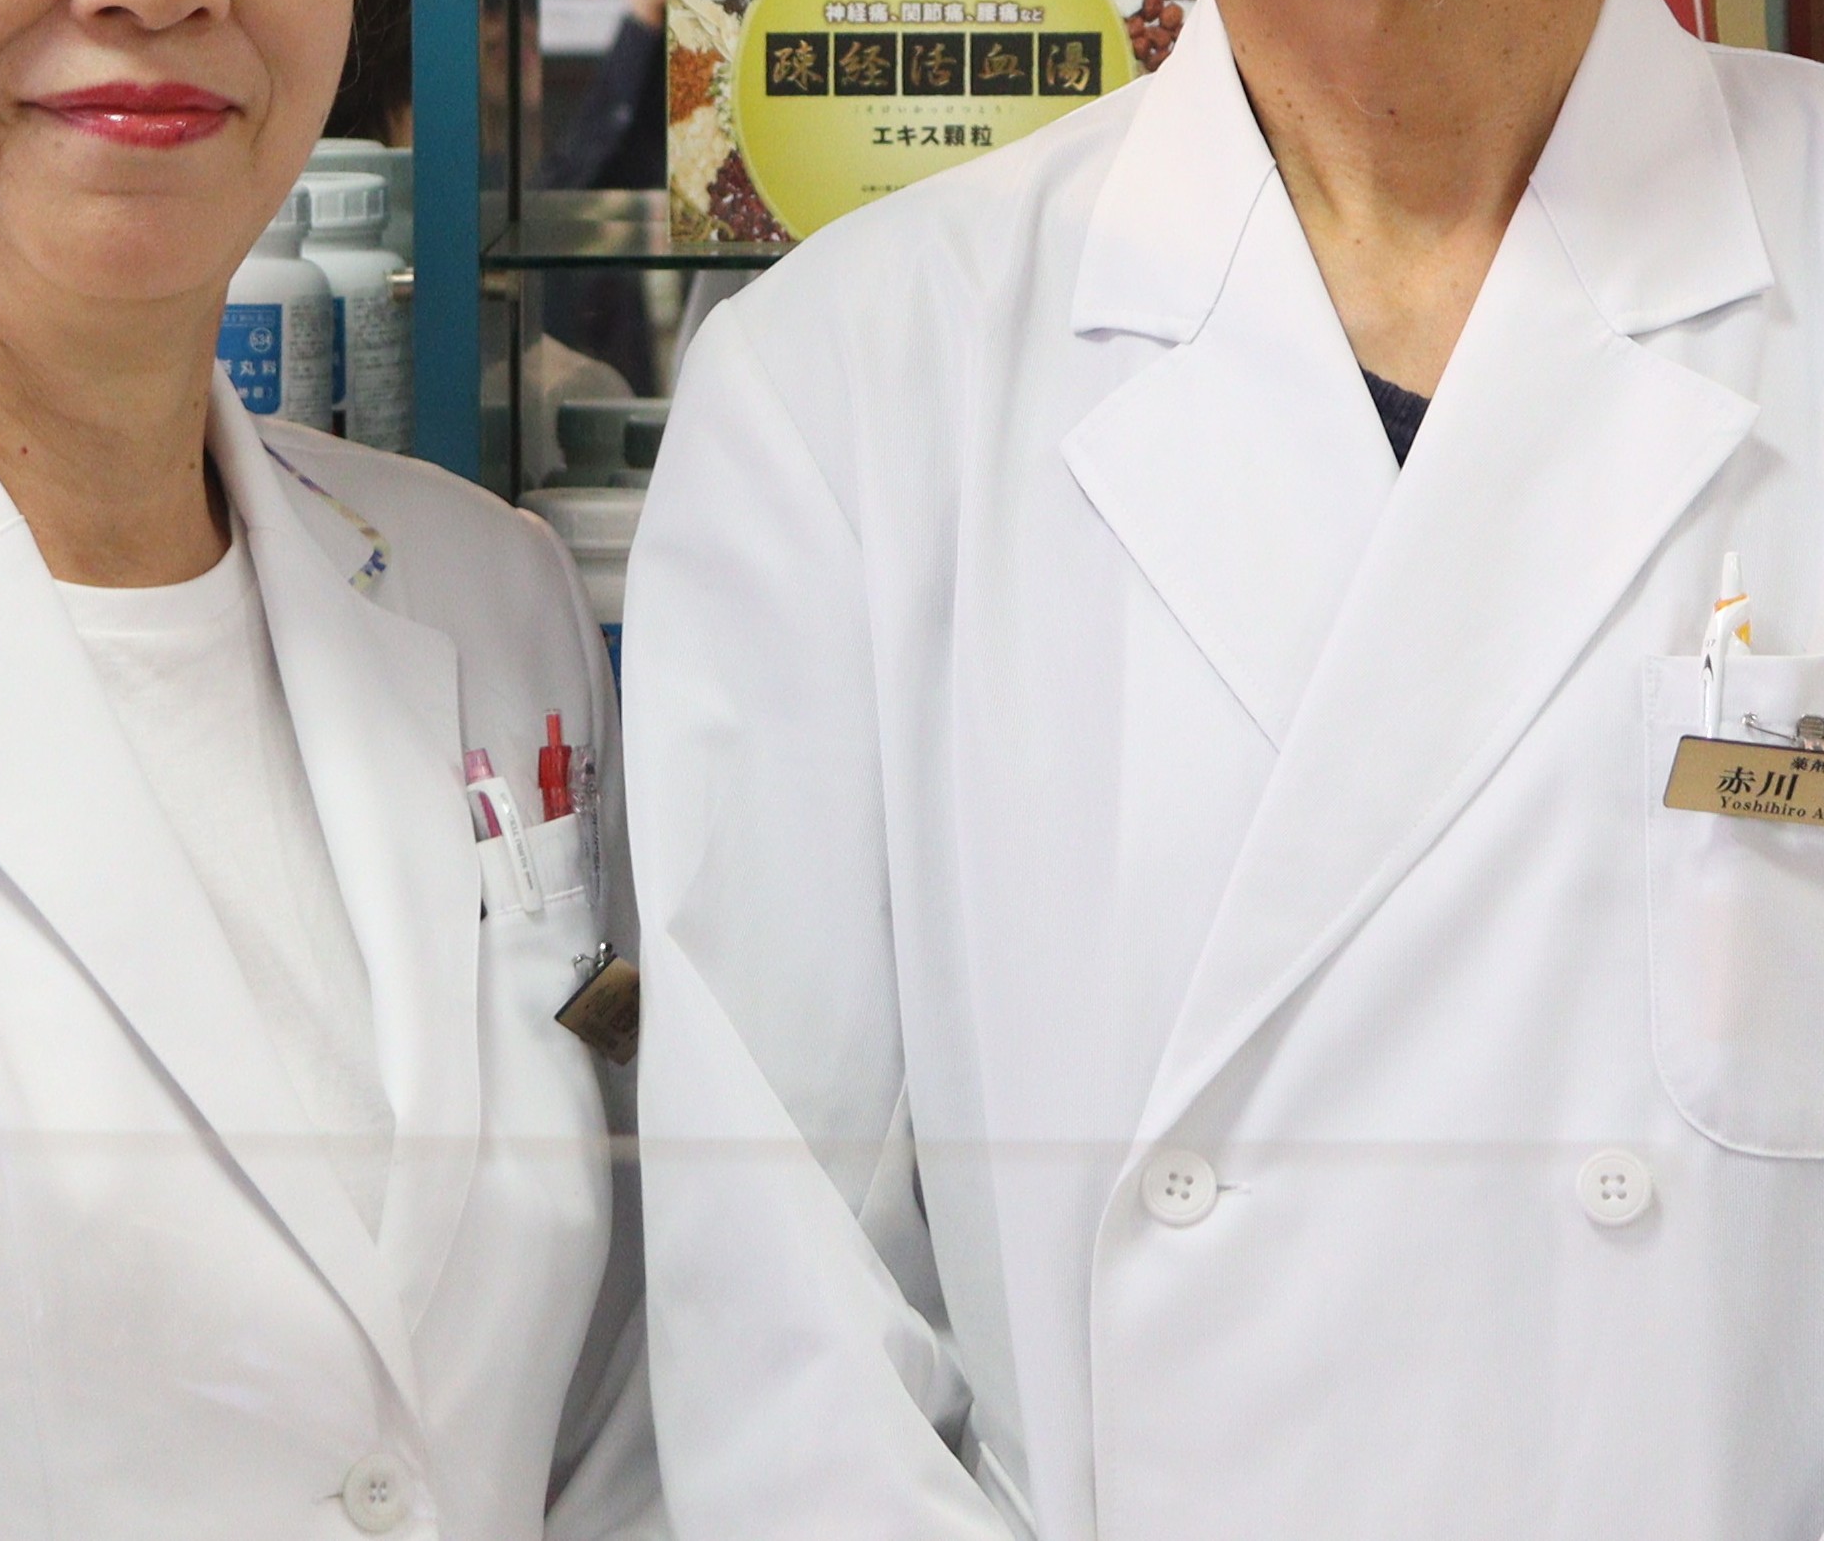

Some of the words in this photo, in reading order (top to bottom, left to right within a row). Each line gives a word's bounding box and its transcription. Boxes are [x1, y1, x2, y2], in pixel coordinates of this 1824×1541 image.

[872, 124, 994, 147] エキス顆粒
[1716, 766, 1800, 801] 赤川
[1719, 796, 1806, 819] Yoshihiro
